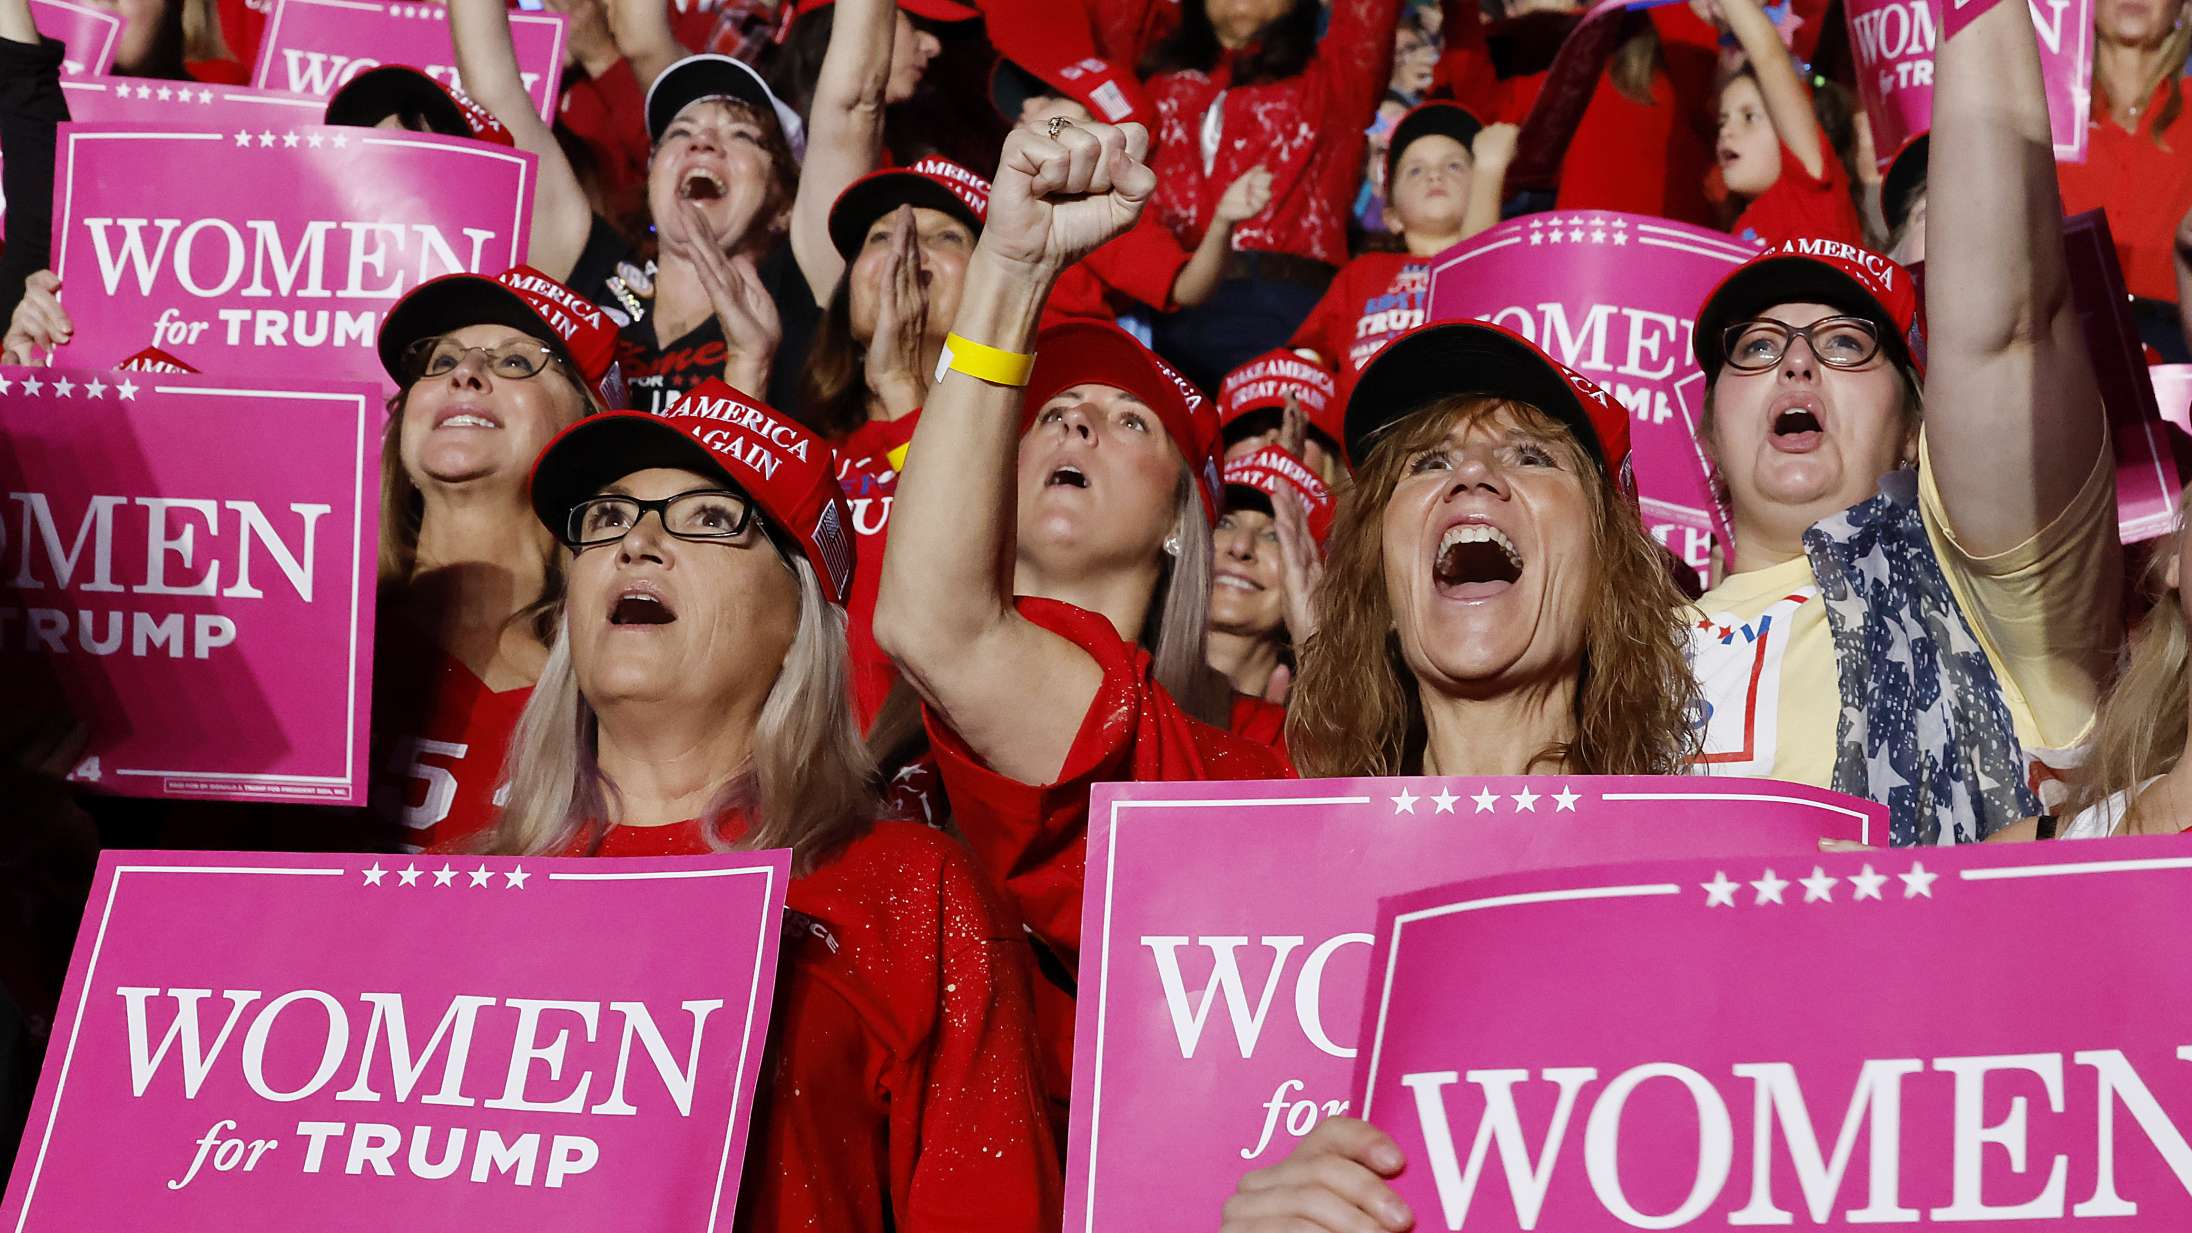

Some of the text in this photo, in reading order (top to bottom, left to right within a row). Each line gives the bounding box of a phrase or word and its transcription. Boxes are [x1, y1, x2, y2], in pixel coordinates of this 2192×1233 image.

[914, 160, 991, 195] AMERIC
[83, 217, 496, 299] WOMEN
[1782, 238, 1894, 292] AMERICA
[153, 308, 386, 348] for TRUM
[498, 273, 601, 331] AMERICA
[1266, 359, 1335, 398] AMERICA
[667, 396, 810, 464] AMERICA
[691, 425, 784, 482] GAIN
[0, 492, 332, 603] MEN
[115, 986, 725, 1117] WOMEN
[167, 1119, 600, 1190] for TRUMP
[1401, 1045, 2192, 1233] WOMEN
